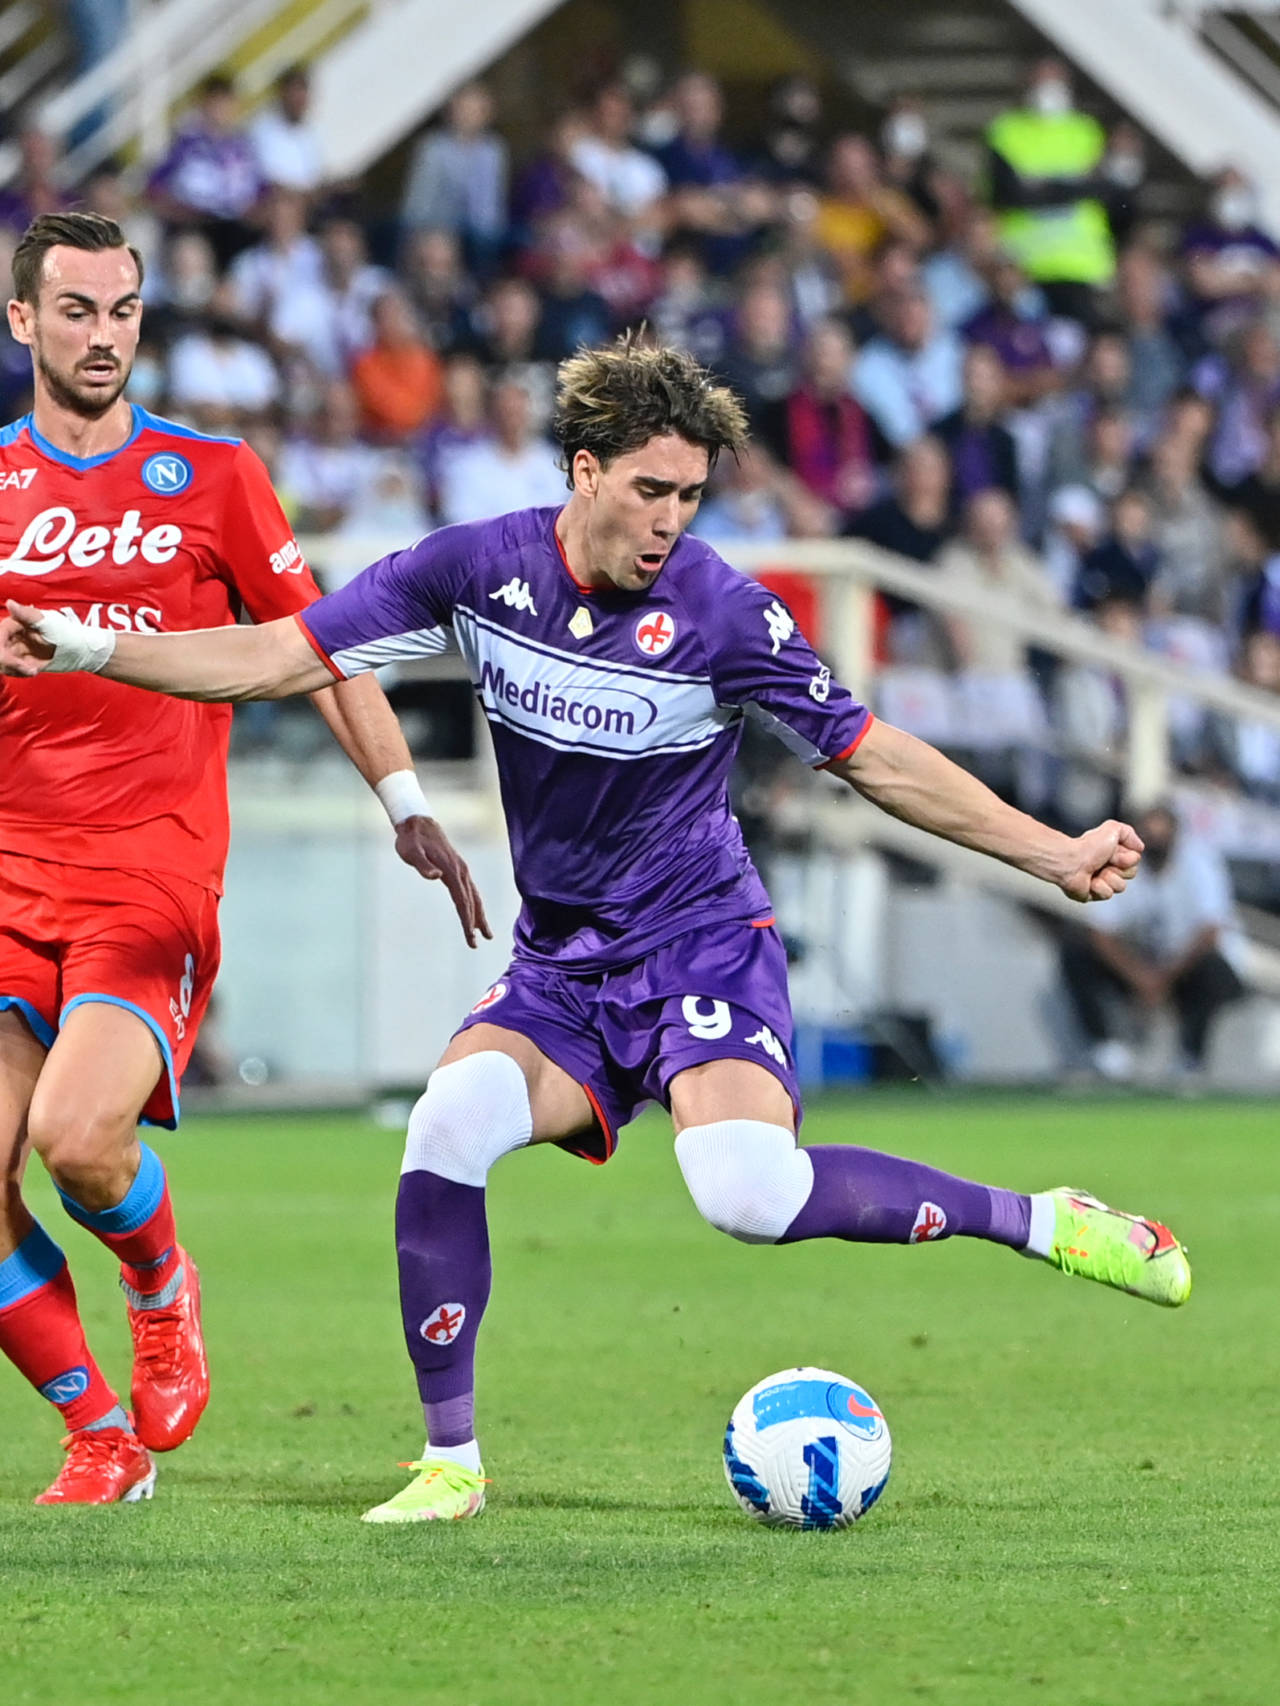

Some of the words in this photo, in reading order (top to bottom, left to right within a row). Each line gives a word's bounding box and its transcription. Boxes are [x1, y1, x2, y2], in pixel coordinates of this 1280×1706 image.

[154, 462, 179, 486] N
[480, 660, 636, 736] Mediacom
[180, 953, 195, 1018] 8
[681, 994, 733, 1040] 9
[53, 1377, 81, 1400] N
